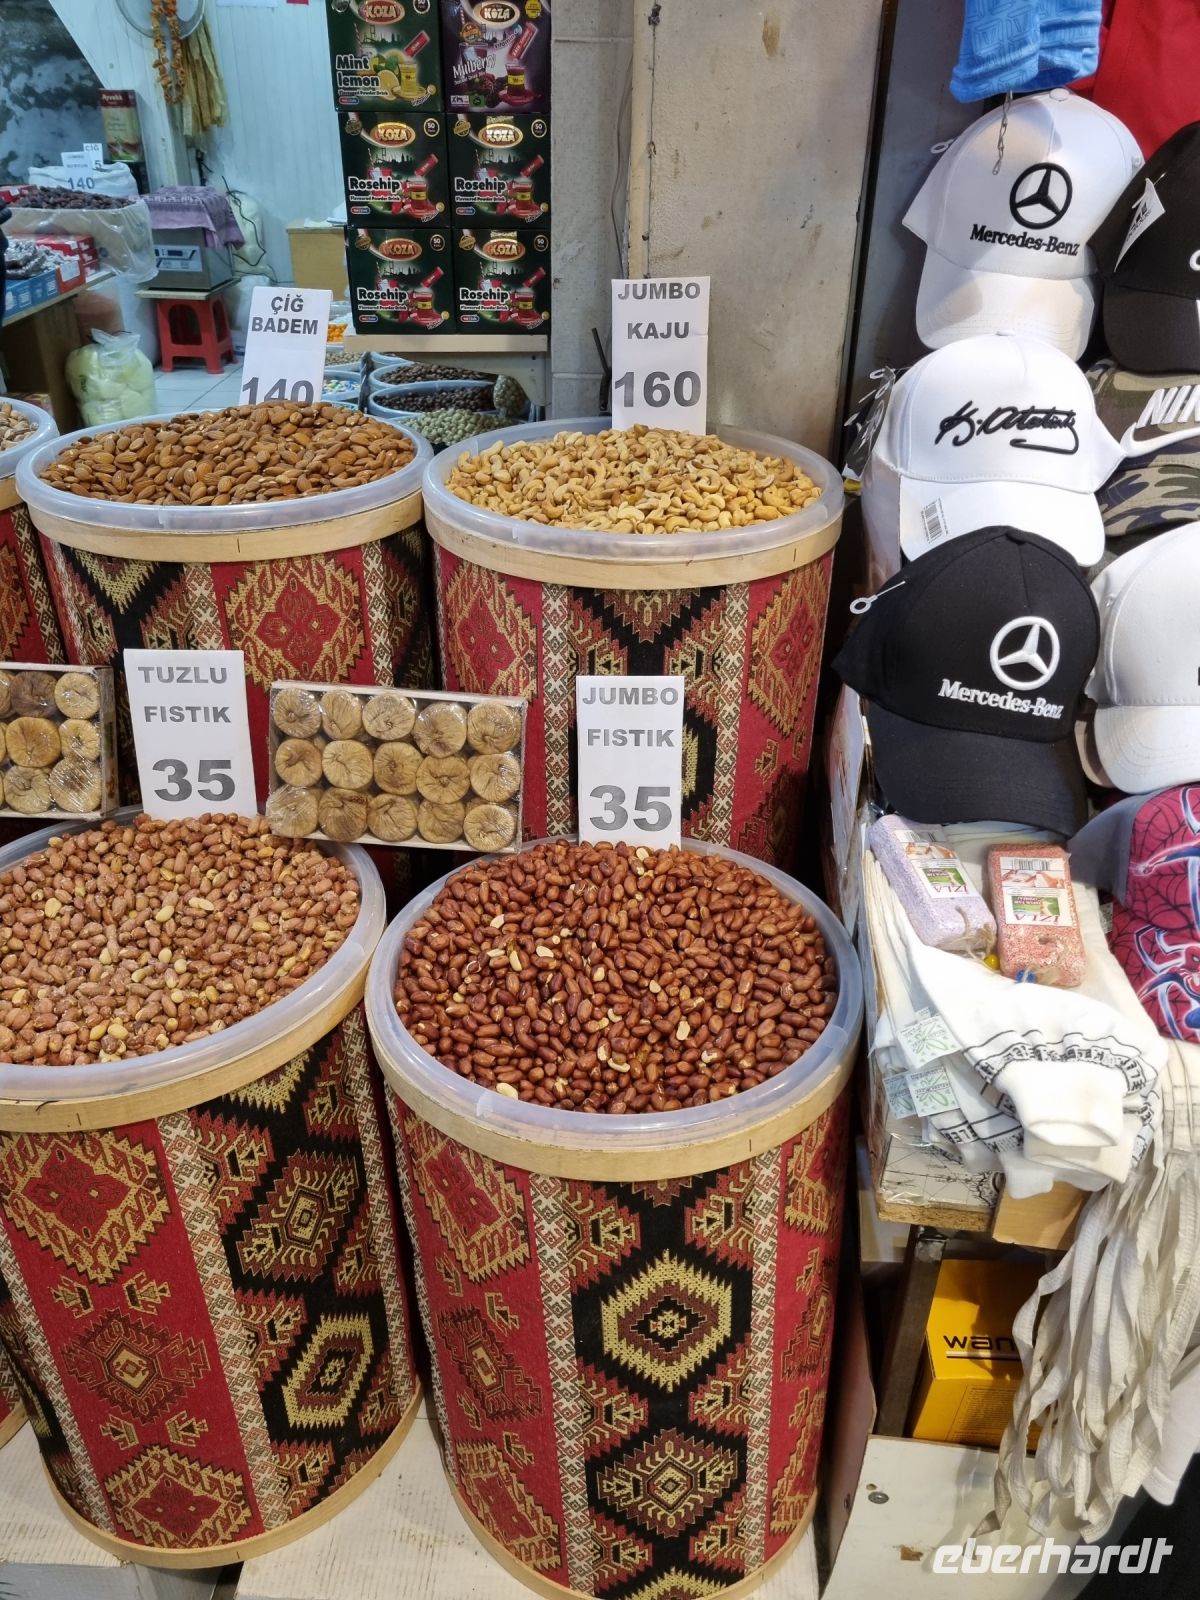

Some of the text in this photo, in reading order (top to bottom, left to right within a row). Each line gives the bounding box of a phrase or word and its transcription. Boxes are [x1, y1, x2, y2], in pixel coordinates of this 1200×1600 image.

[483, 7, 511, 20] KOZA
[336, 54, 369, 71] Mint
[338, 72, 380, 87] lemon
[67, 177, 95, 189] 140
[348, 176, 401, 193] Rosehip
[454, 177, 507, 193] Rosehip
[970, 224, 1080, 256] Mercedes-Benz
[357, 287, 407, 303] Rosehip
[459, 287, 509, 303] Rosehip
[618, 282, 701, 300] JUMBO
[271, 293, 304, 315] ÇİĞ
[251, 317, 319, 335] BADEM
[627, 321, 690, 339] KAJU
[242, 377, 315, 406] 140
[614, 370, 702, 408] 160
[137, 666, 228, 684] TUZLU
[582, 687, 679, 705] JUMBO
[938, 678, 1064, 719] Mercedes-Benz
[144, 705, 231, 723] FISTIK
[587, 728, 675, 747] FISTIK
[152, 758, 236, 802] 35
[589, 784, 673, 832] 35
